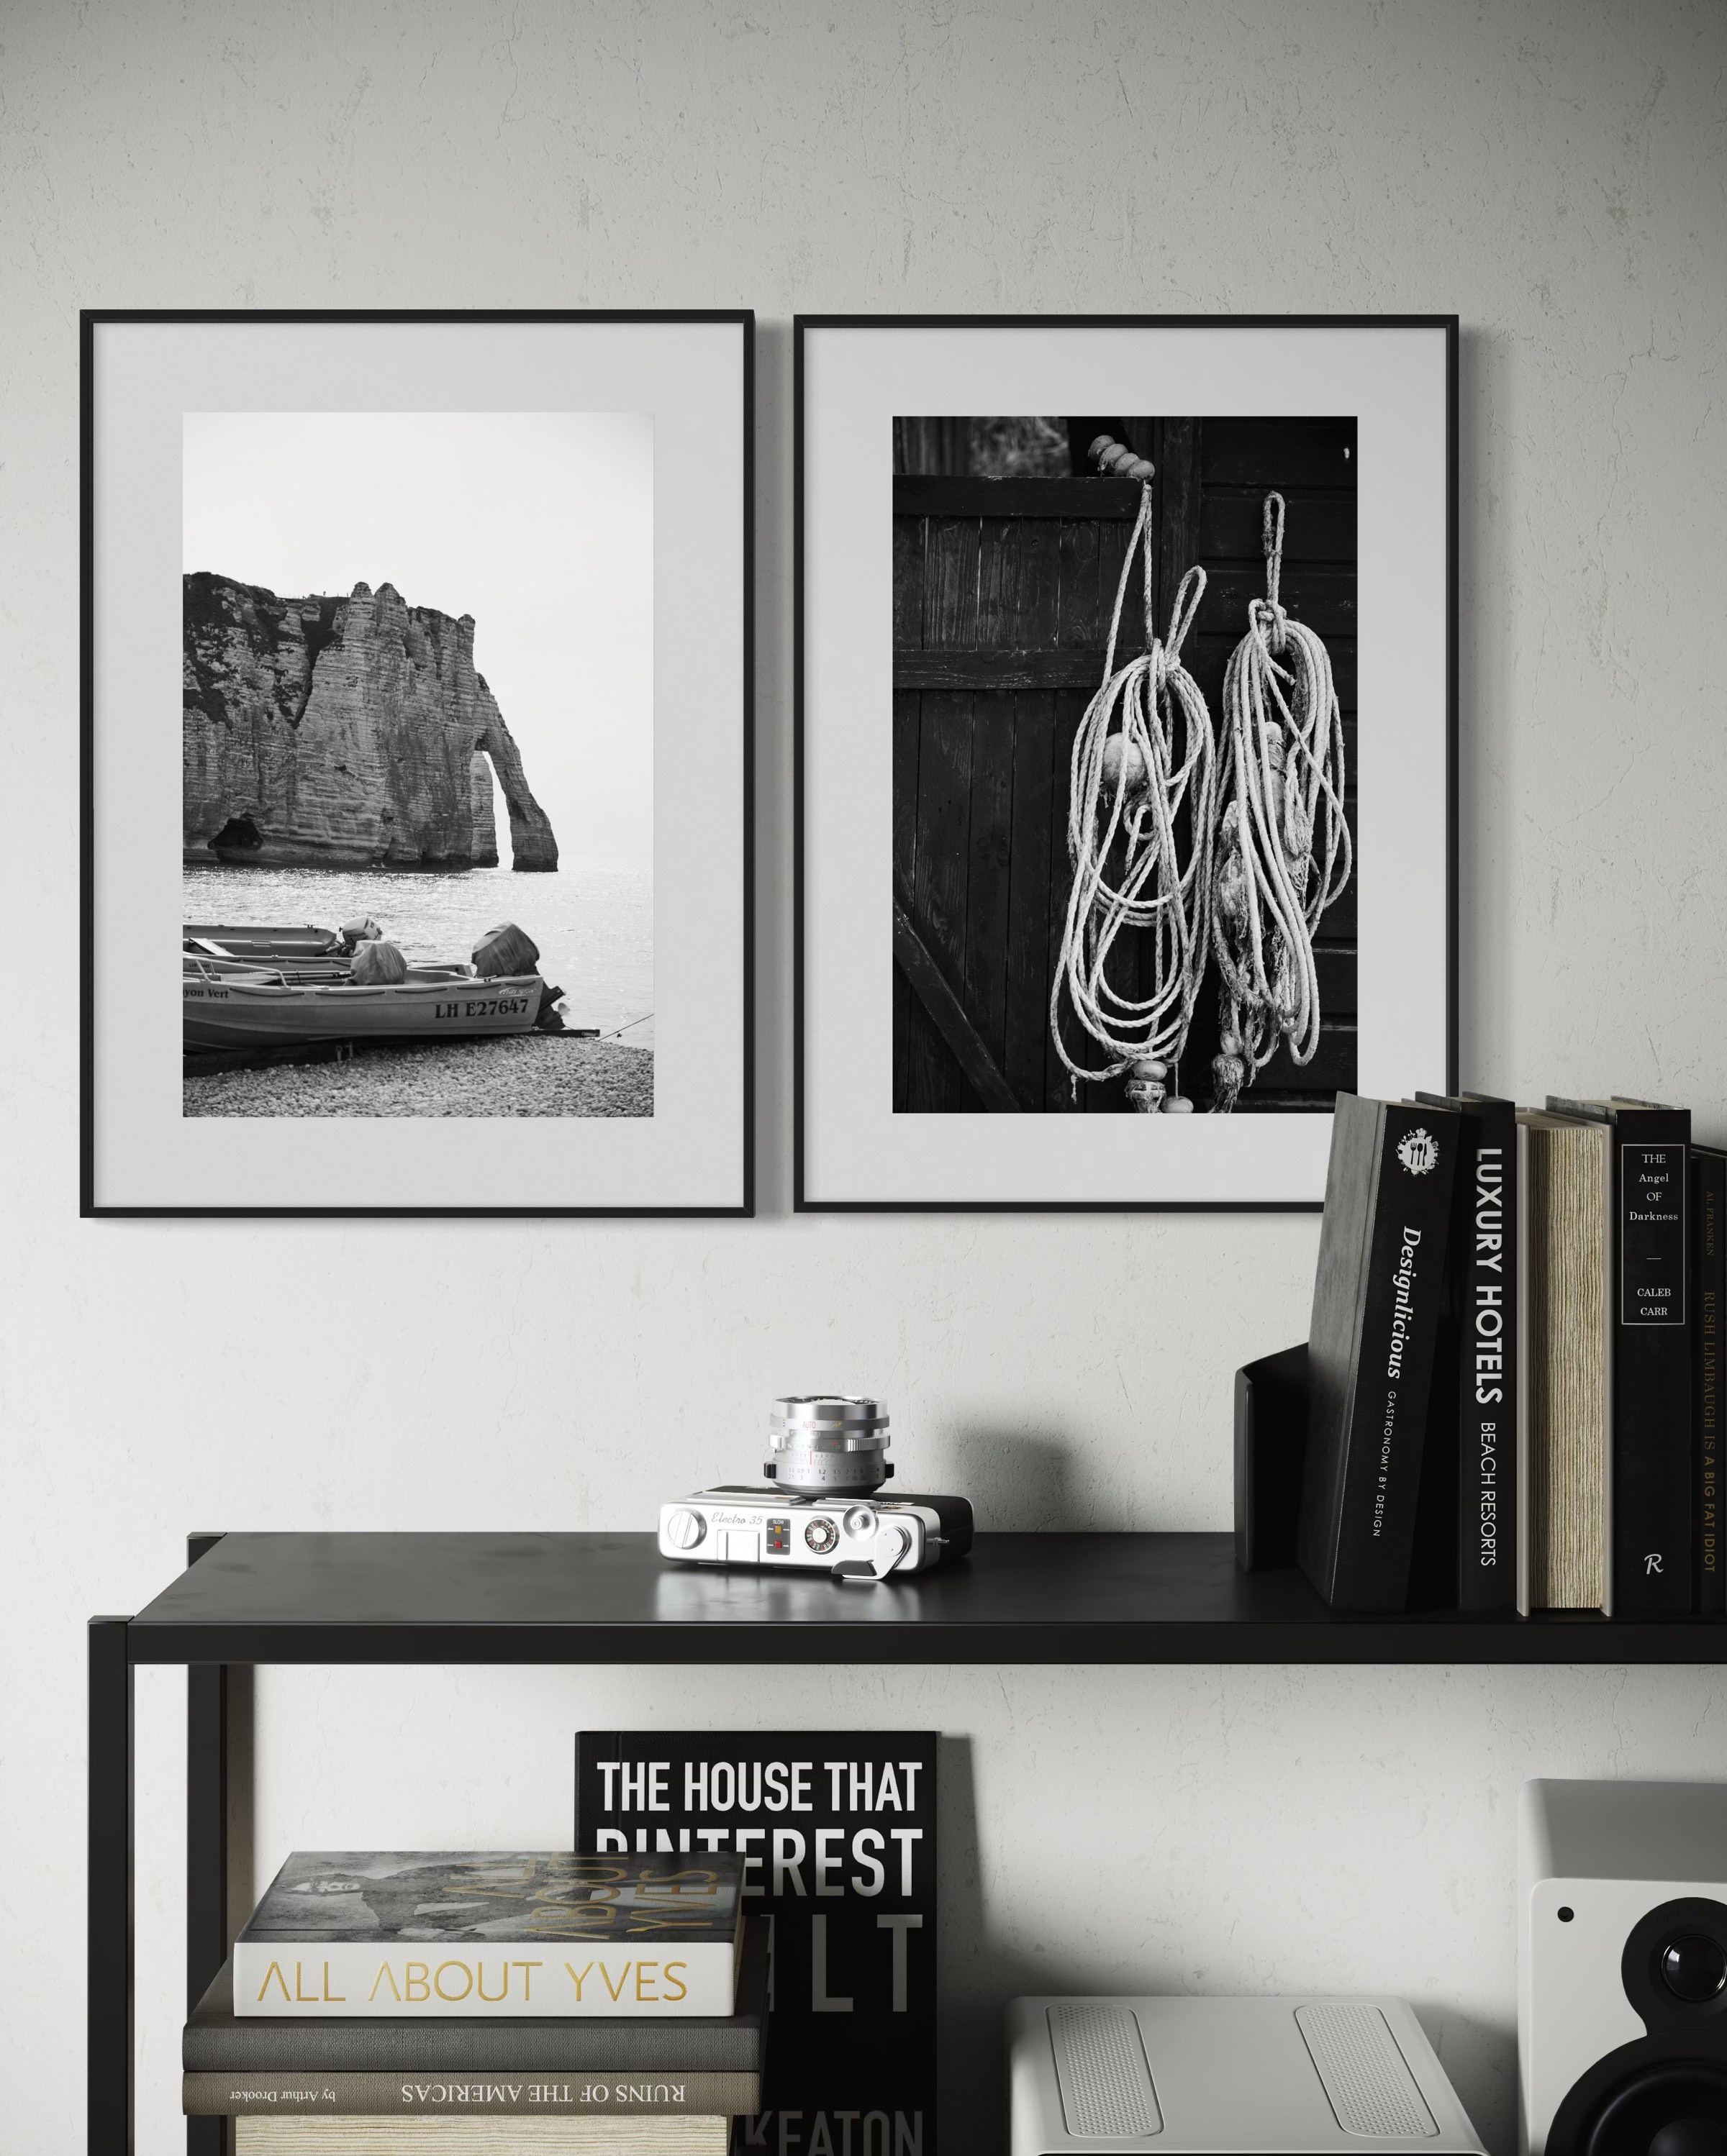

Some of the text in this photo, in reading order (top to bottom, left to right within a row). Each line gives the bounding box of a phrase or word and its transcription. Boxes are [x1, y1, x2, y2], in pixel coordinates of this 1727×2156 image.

[183, 988, 229, 999] yon Vert
[435, 999, 529, 1019] LH E27647
[1639, 1173, 1668, 1183] Angel
[1707, 1191, 1713, 1204] AL
[1630, 1211, 1677, 1220] Darkness
[1476, 1149, 1502, 1404] LUXURY HOTELS
[1388, 1226, 1421, 1378] Designlicious
[1705, 1292, 1715, 1571] RUSH LIMBAUGH IS A BIG FAT IDIOT
[1373, 1391, 1396, 1536] GASTRONOMY BY DESIGN
[1481, 1423, 1496, 1565] BEACH RESORTS
[711, 1511, 763, 1525] Electro 35
[597, 1762, 922, 1811] THE HOUSE THAT
[625, 1869, 719, 1934] YVES
[258, 1960, 686, 2001] ALL ABOUT YVES
[230, 2089, 336, 2102] by Arthur Drooker
[402, 2084, 686, 2102] RUINS OF THE AMERICAS
